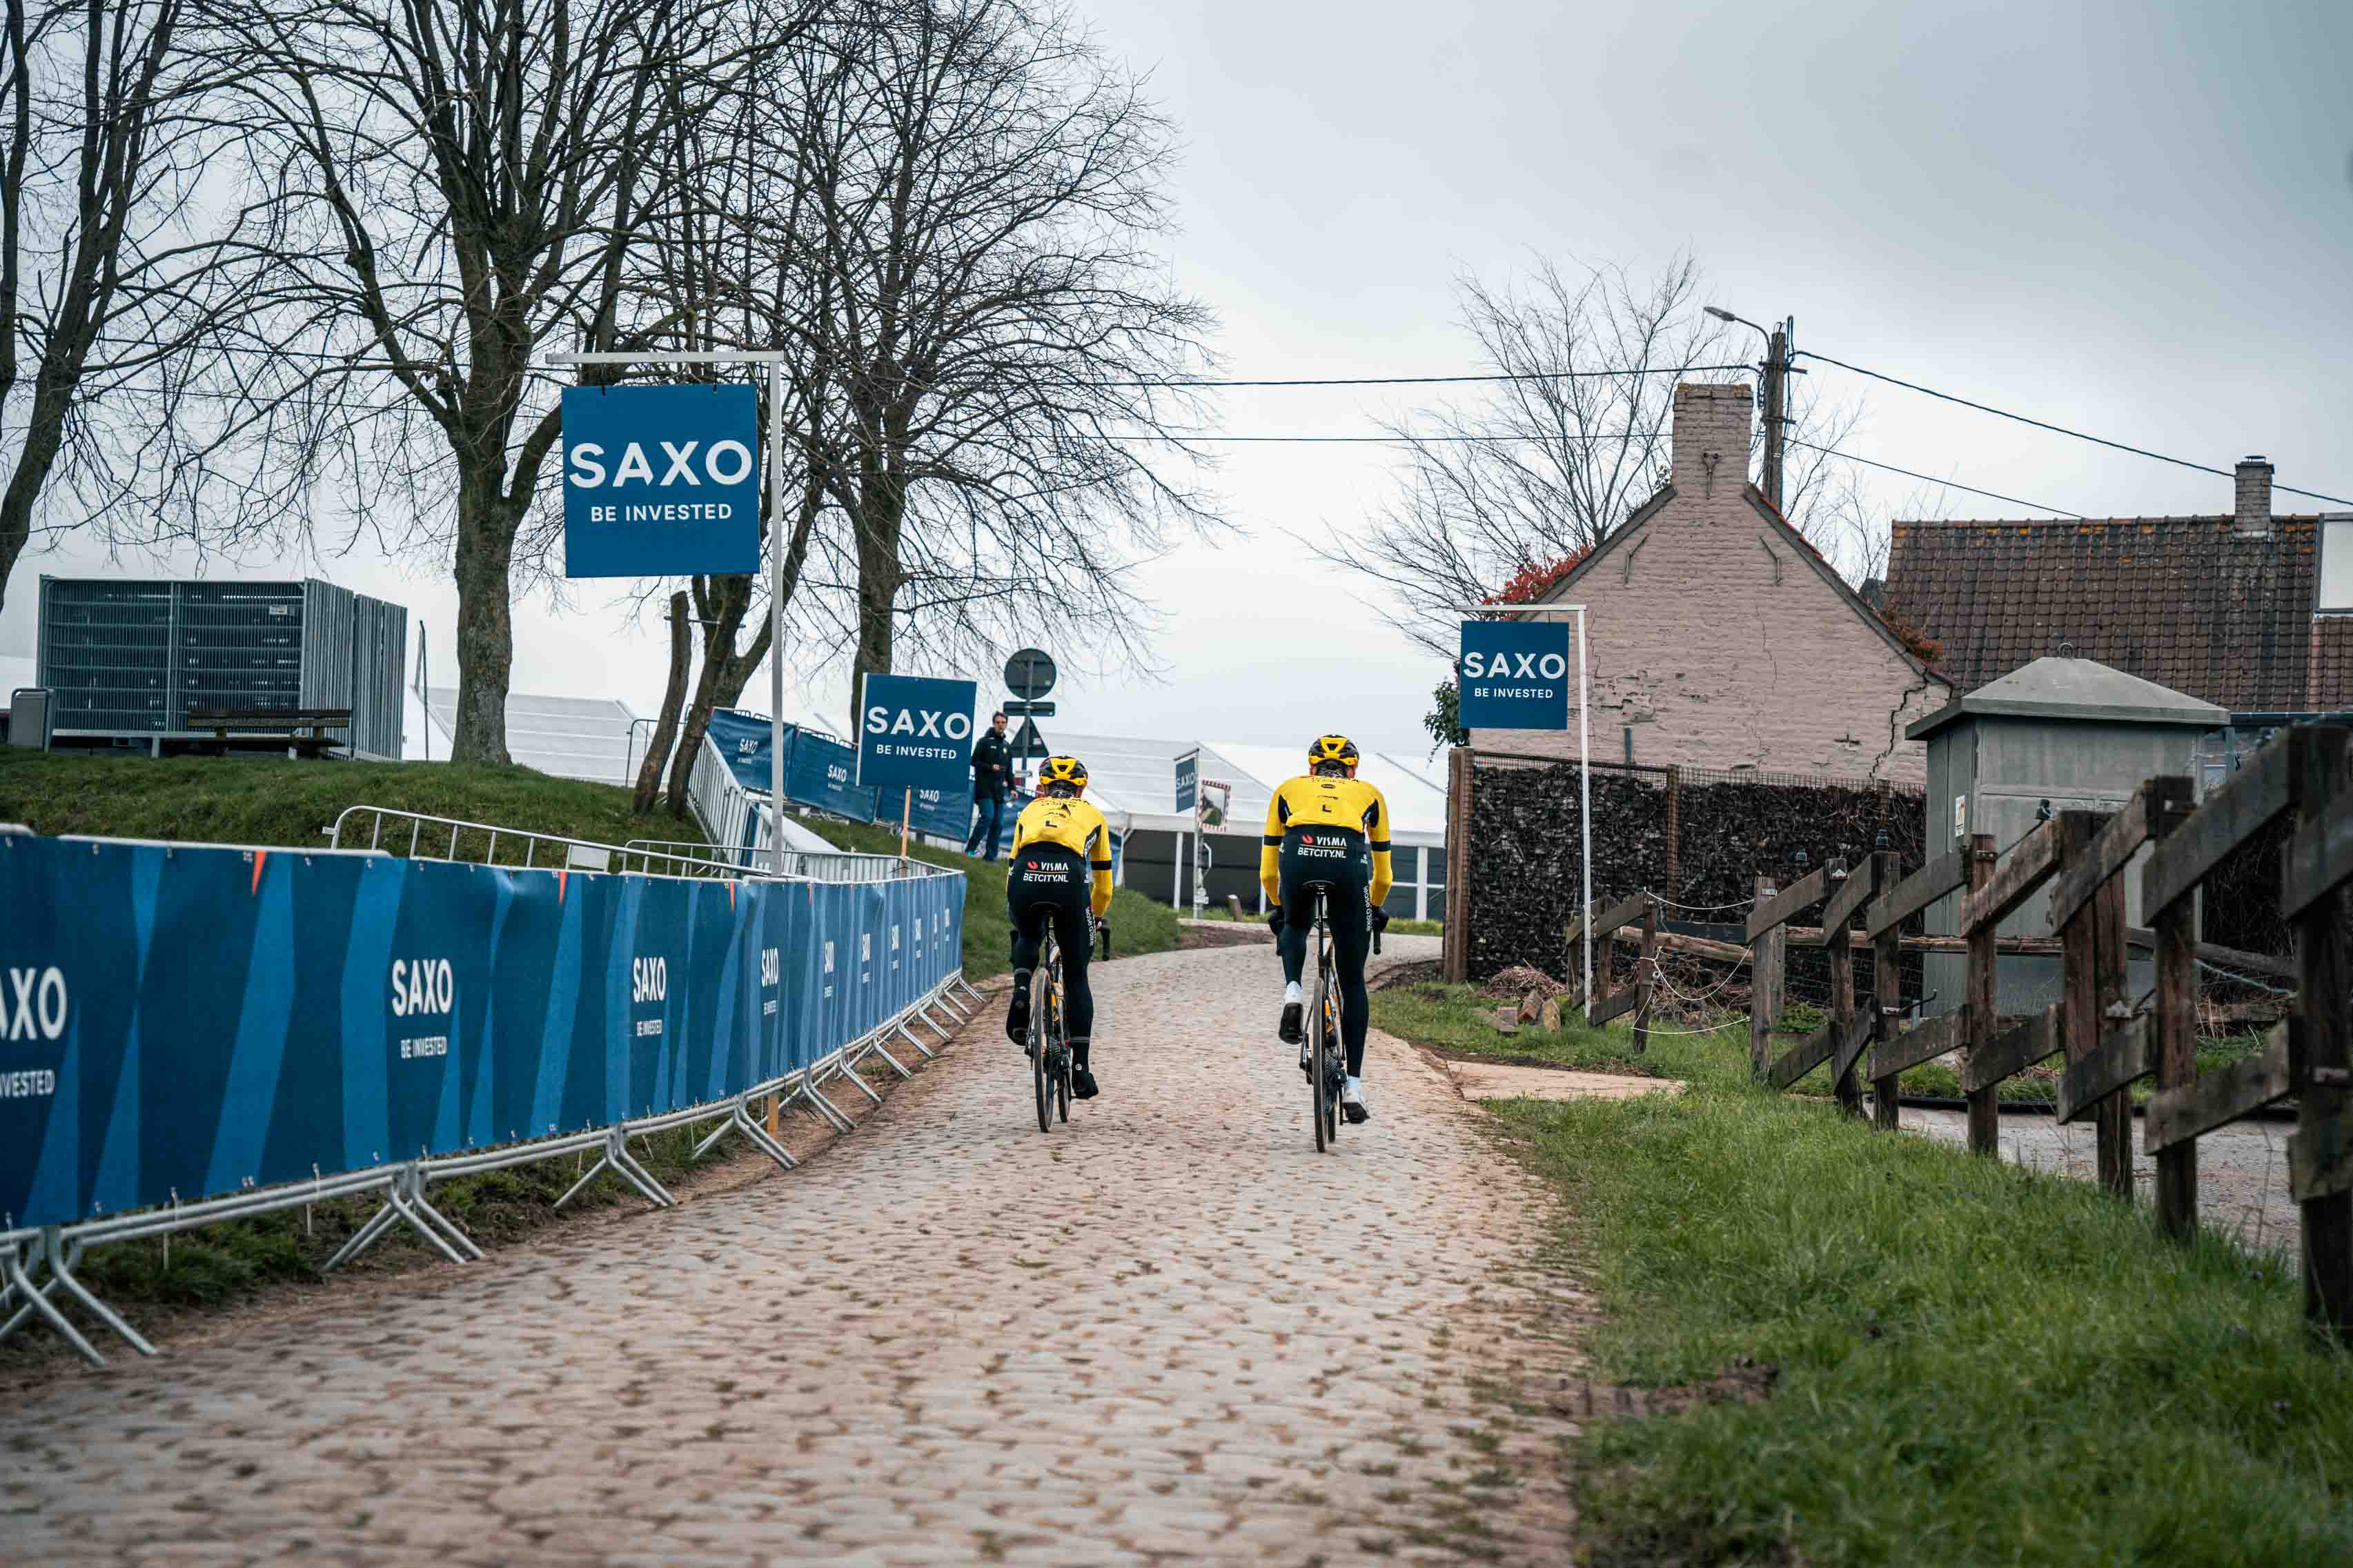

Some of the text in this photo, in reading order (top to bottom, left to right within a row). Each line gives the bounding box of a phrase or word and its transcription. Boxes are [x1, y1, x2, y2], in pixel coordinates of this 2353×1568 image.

[569, 439, 753, 488] SAXO
[591, 504, 732, 522] BE INVESTED
[1463, 651, 1566, 679] SAXO
[1474, 688, 1553, 699] BE INVESTED
[866, 706, 972, 740] SAXO
[739, 737, 758, 754] SAXO
[876, 744, 957, 760] BE INVESTED
[827, 764, 847, 782] SAXO
[1317, 836, 1347, 846] VISMA
[1297, 846, 1347, 858] BETCITY.NL
[1041, 862, 1069, 871] VISMA
[1023, 873, 1070, 882] BETCITY.NL
[761, 946, 779, 987] SAXO
[391, 958, 453, 1017] SAXO
[633, 957, 667, 1003] SAXO
[400, 1036, 448, 1059] BE INVESTED
